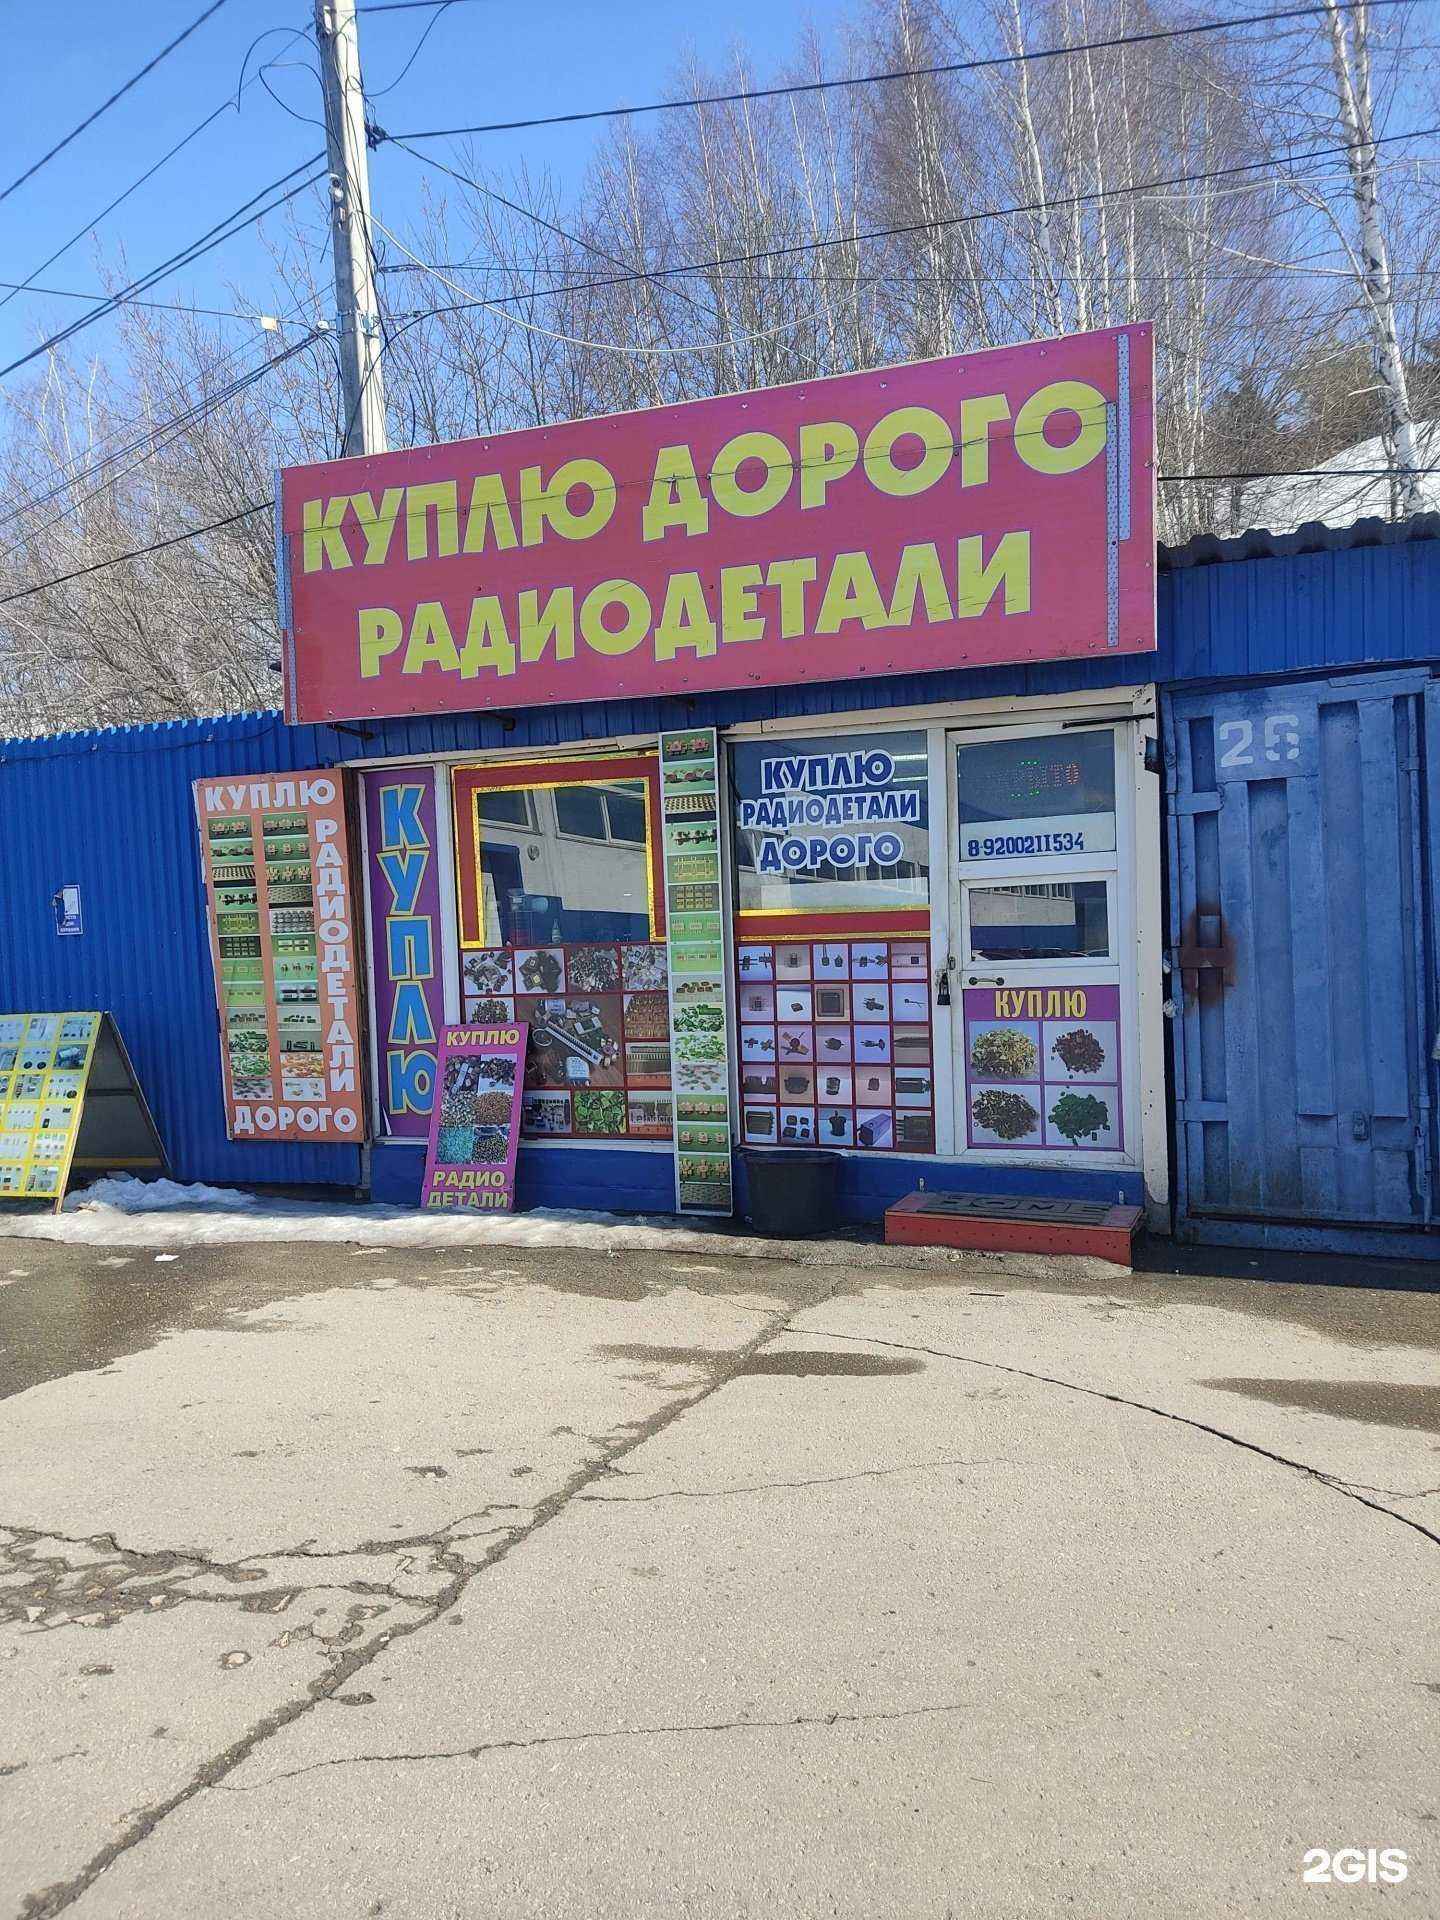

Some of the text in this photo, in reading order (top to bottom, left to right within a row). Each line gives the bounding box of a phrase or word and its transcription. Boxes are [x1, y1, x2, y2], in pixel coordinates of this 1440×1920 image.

[303, 379, 1109, 575] КУПЛЮ ДОРОГО
[358, 530, 1032, 680] РАДИОДЕТАЛИ
[763, 752, 893, 790] КУПЛЮ
[205, 778, 336, 812] КУПЛЮ
[742, 793, 918, 829] РАДИОДЕТАЛИ
[760, 833, 902, 871] ДОРОГО
[315, 818, 356, 1092] РАДИОДЕТАЛИ
[377, 783, 436, 1115] КУПЛЮ
[995, 990, 1087, 1019] КУПЛЮ
[446, 1029, 520, 1046] КУПЛЮ
[233, 1105, 357, 1135] ДОРОГО
[432, 1171, 505, 1189] РАДИО
[427, 1191, 508, 1209] ДЕТАЛИ
